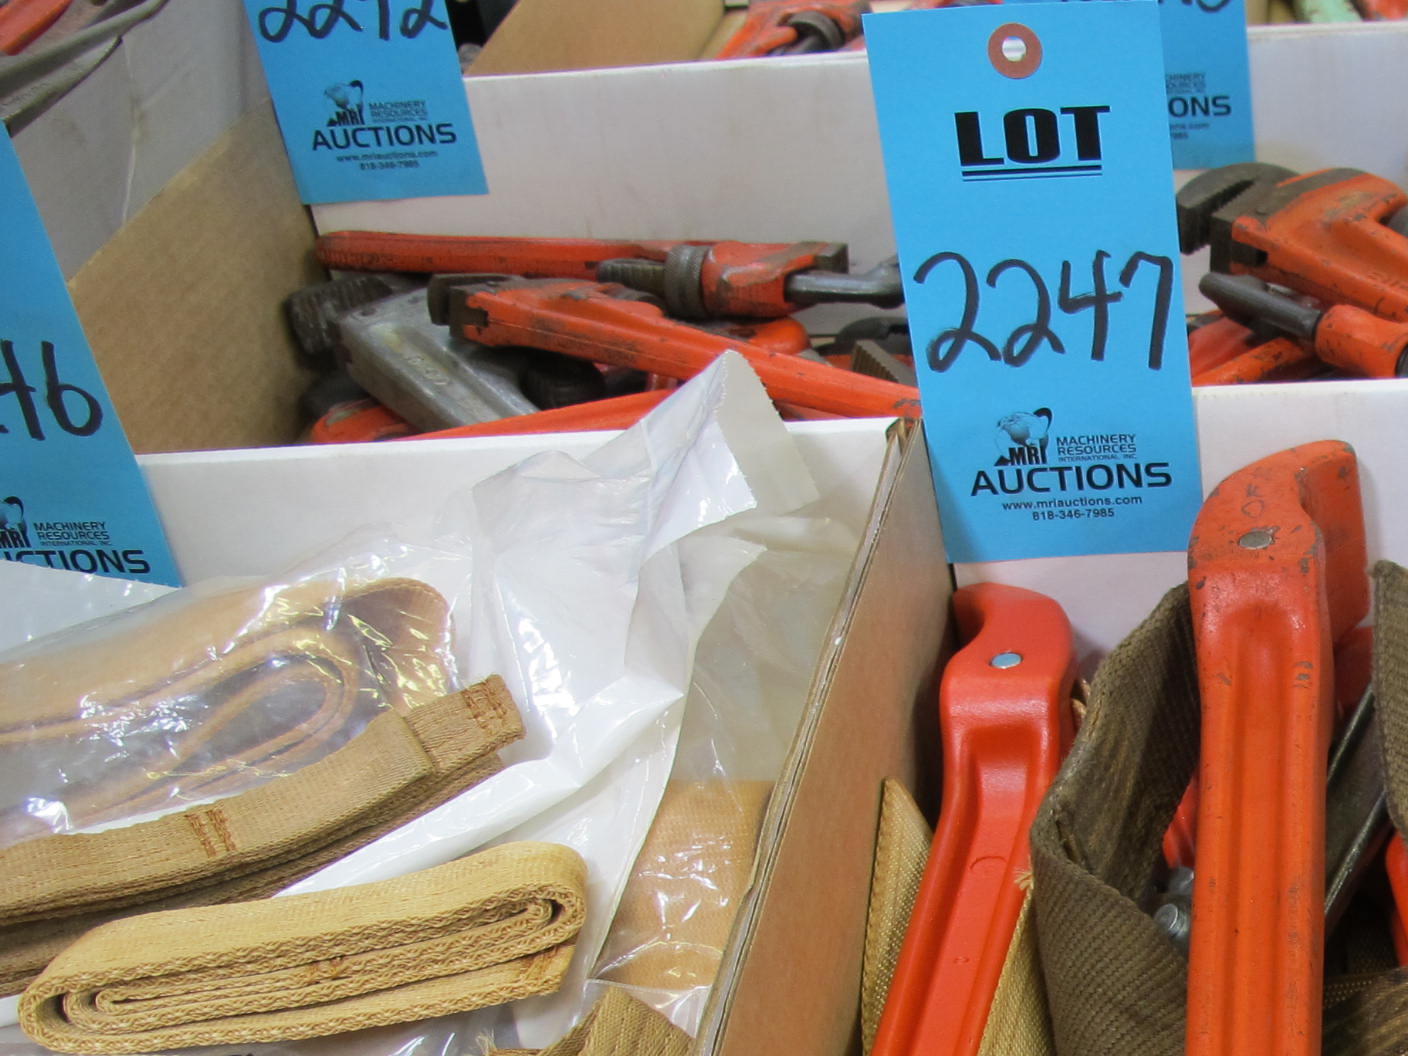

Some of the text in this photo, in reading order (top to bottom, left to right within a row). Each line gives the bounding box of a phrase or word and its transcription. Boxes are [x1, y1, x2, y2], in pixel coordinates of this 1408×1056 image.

[335, 106, 365, 126] MRI
[312, 123, 457, 151] AUCTIONS
[954, 104, 1111, 167] LOT
[913, 250, 1174, 373] 2247
[1056, 433, 1137, 447] MACHINERY
[1008, 445, 1048, 466] MRI
[1057, 444, 1137, 456] RESOURCES
[1058, 454, 1119, 463] INTERNATIONAL
[970, 462, 1173, 497] AUCTIONS
[1002, 495, 1143, 511] www.mriauctions.com
[1032, 508, 1115, 521] 818-346-7985
[33, 521, 107, 532] MACHINERY
[37, 530, 110, 541] RESOURCES
